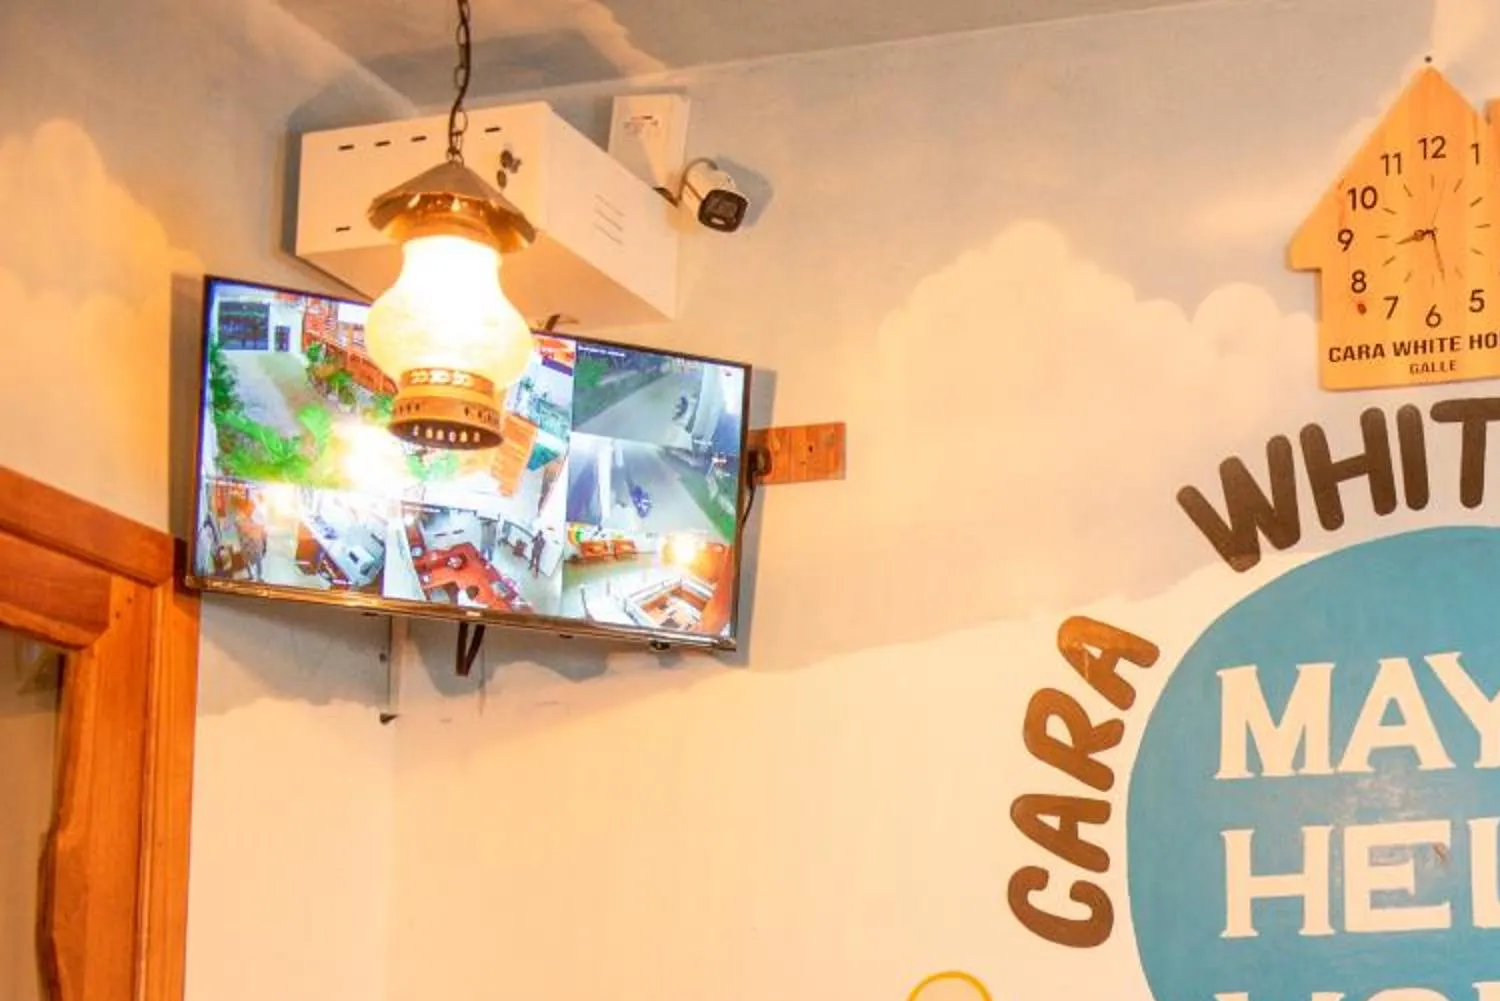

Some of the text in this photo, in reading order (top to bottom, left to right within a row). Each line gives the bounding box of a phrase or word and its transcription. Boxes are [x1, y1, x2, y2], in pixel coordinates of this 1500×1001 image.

[1418, 136, 1447, 160] 12
[1471, 143, 1480, 165] 1
[1381, 152, 1402, 176] 11
[1347, 185, 1378, 212] 10
[1337, 229, 1354, 252] 9
[1350, 270, 1367, 294] 8
[1383, 296, 1399, 320] 7
[1469, 289, 1485, 313] 5
[1425, 304, 1442, 328] 6
[1328, 343, 1386, 363] CARA
[1392, 335, 1462, 357] WHITE
[1408, 359, 1457, 375] GALLE
[1007, 614, 1160, 948] CARA
